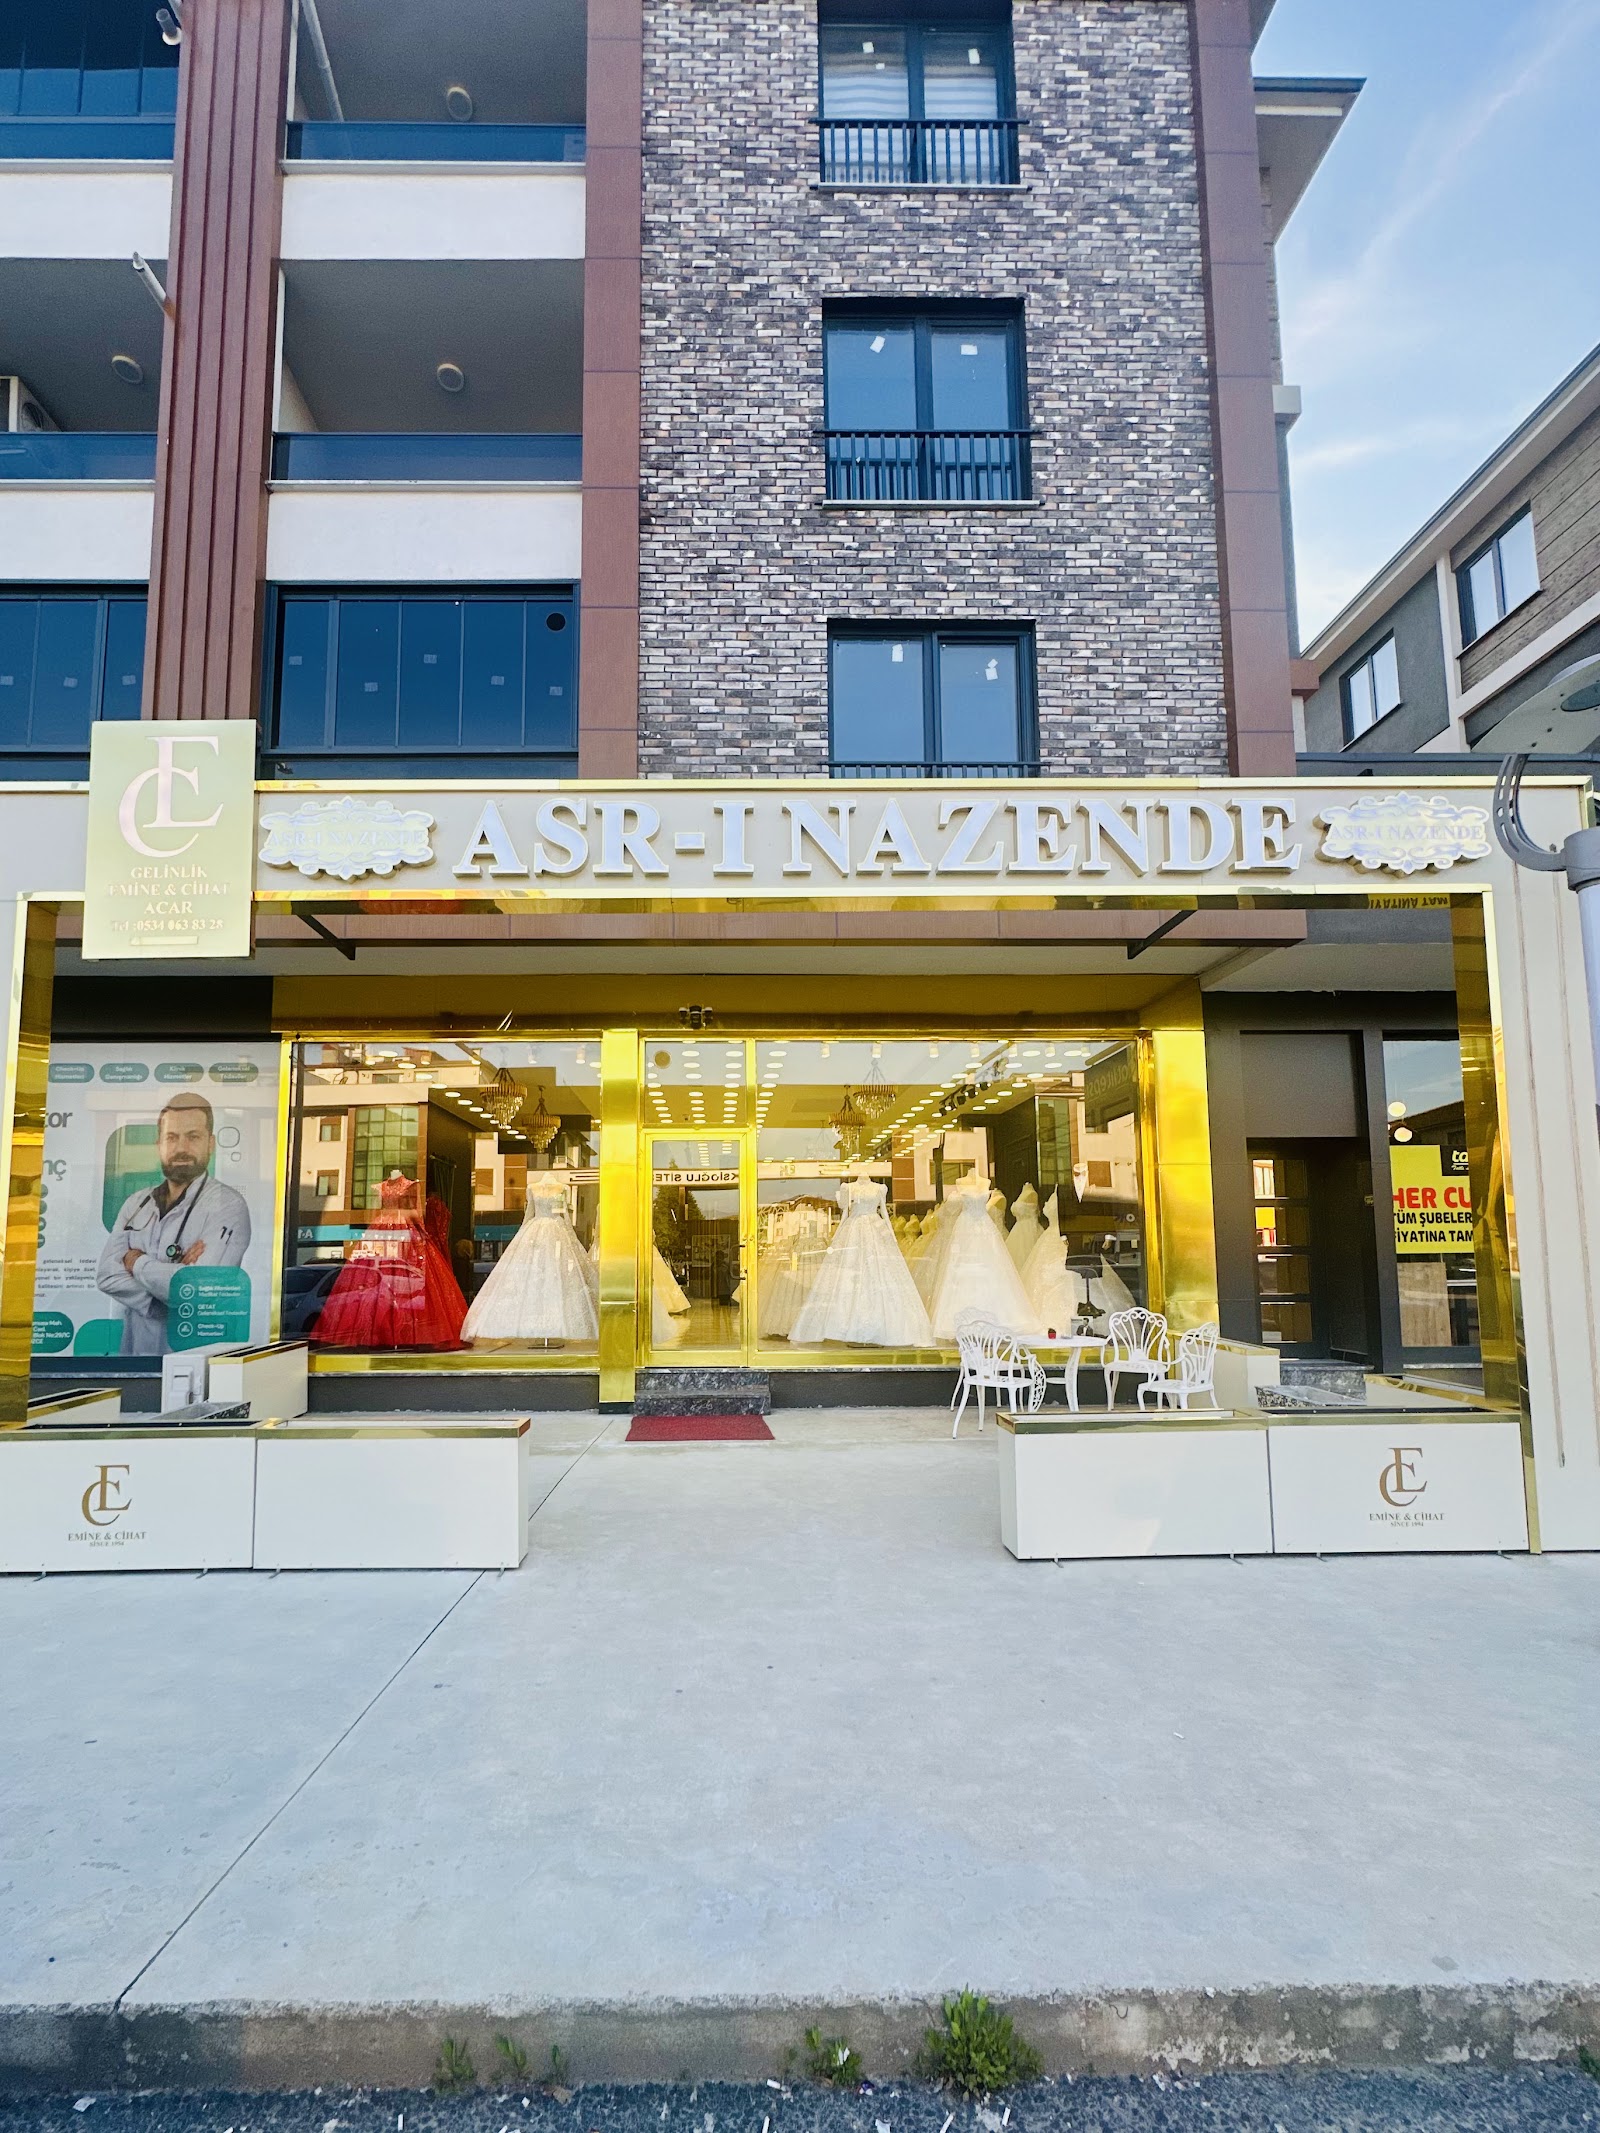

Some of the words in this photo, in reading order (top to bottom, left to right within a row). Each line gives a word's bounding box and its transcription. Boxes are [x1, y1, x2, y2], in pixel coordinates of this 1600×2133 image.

[452, 797, 754, 878] ASR-I
[782, 796, 1303, 878] NAZENDE
[1329, 824, 1384, 841] ASR-I
[1387, 824, 1483, 841] NAZENDE
[130, 863, 208, 879] GELİNLİK
[108, 881, 161, 897] EMİNE
[164, 883, 177, 897] &
[143, 900, 193, 915] ACAR
[1392, 1187, 1437, 1209] HER
[1395, 1227, 1446, 1243] İYATINA
[1369, 1511, 1401, 1521] EMİNE
[1403, 1512, 1411, 1521] &
[1413, 1511, 1445, 1521] CİHAT
[68, 1531, 102, 1542] EMİNE
[103, 1531, 112, 1541] &
[114, 1530, 147, 1540] CİHAT
